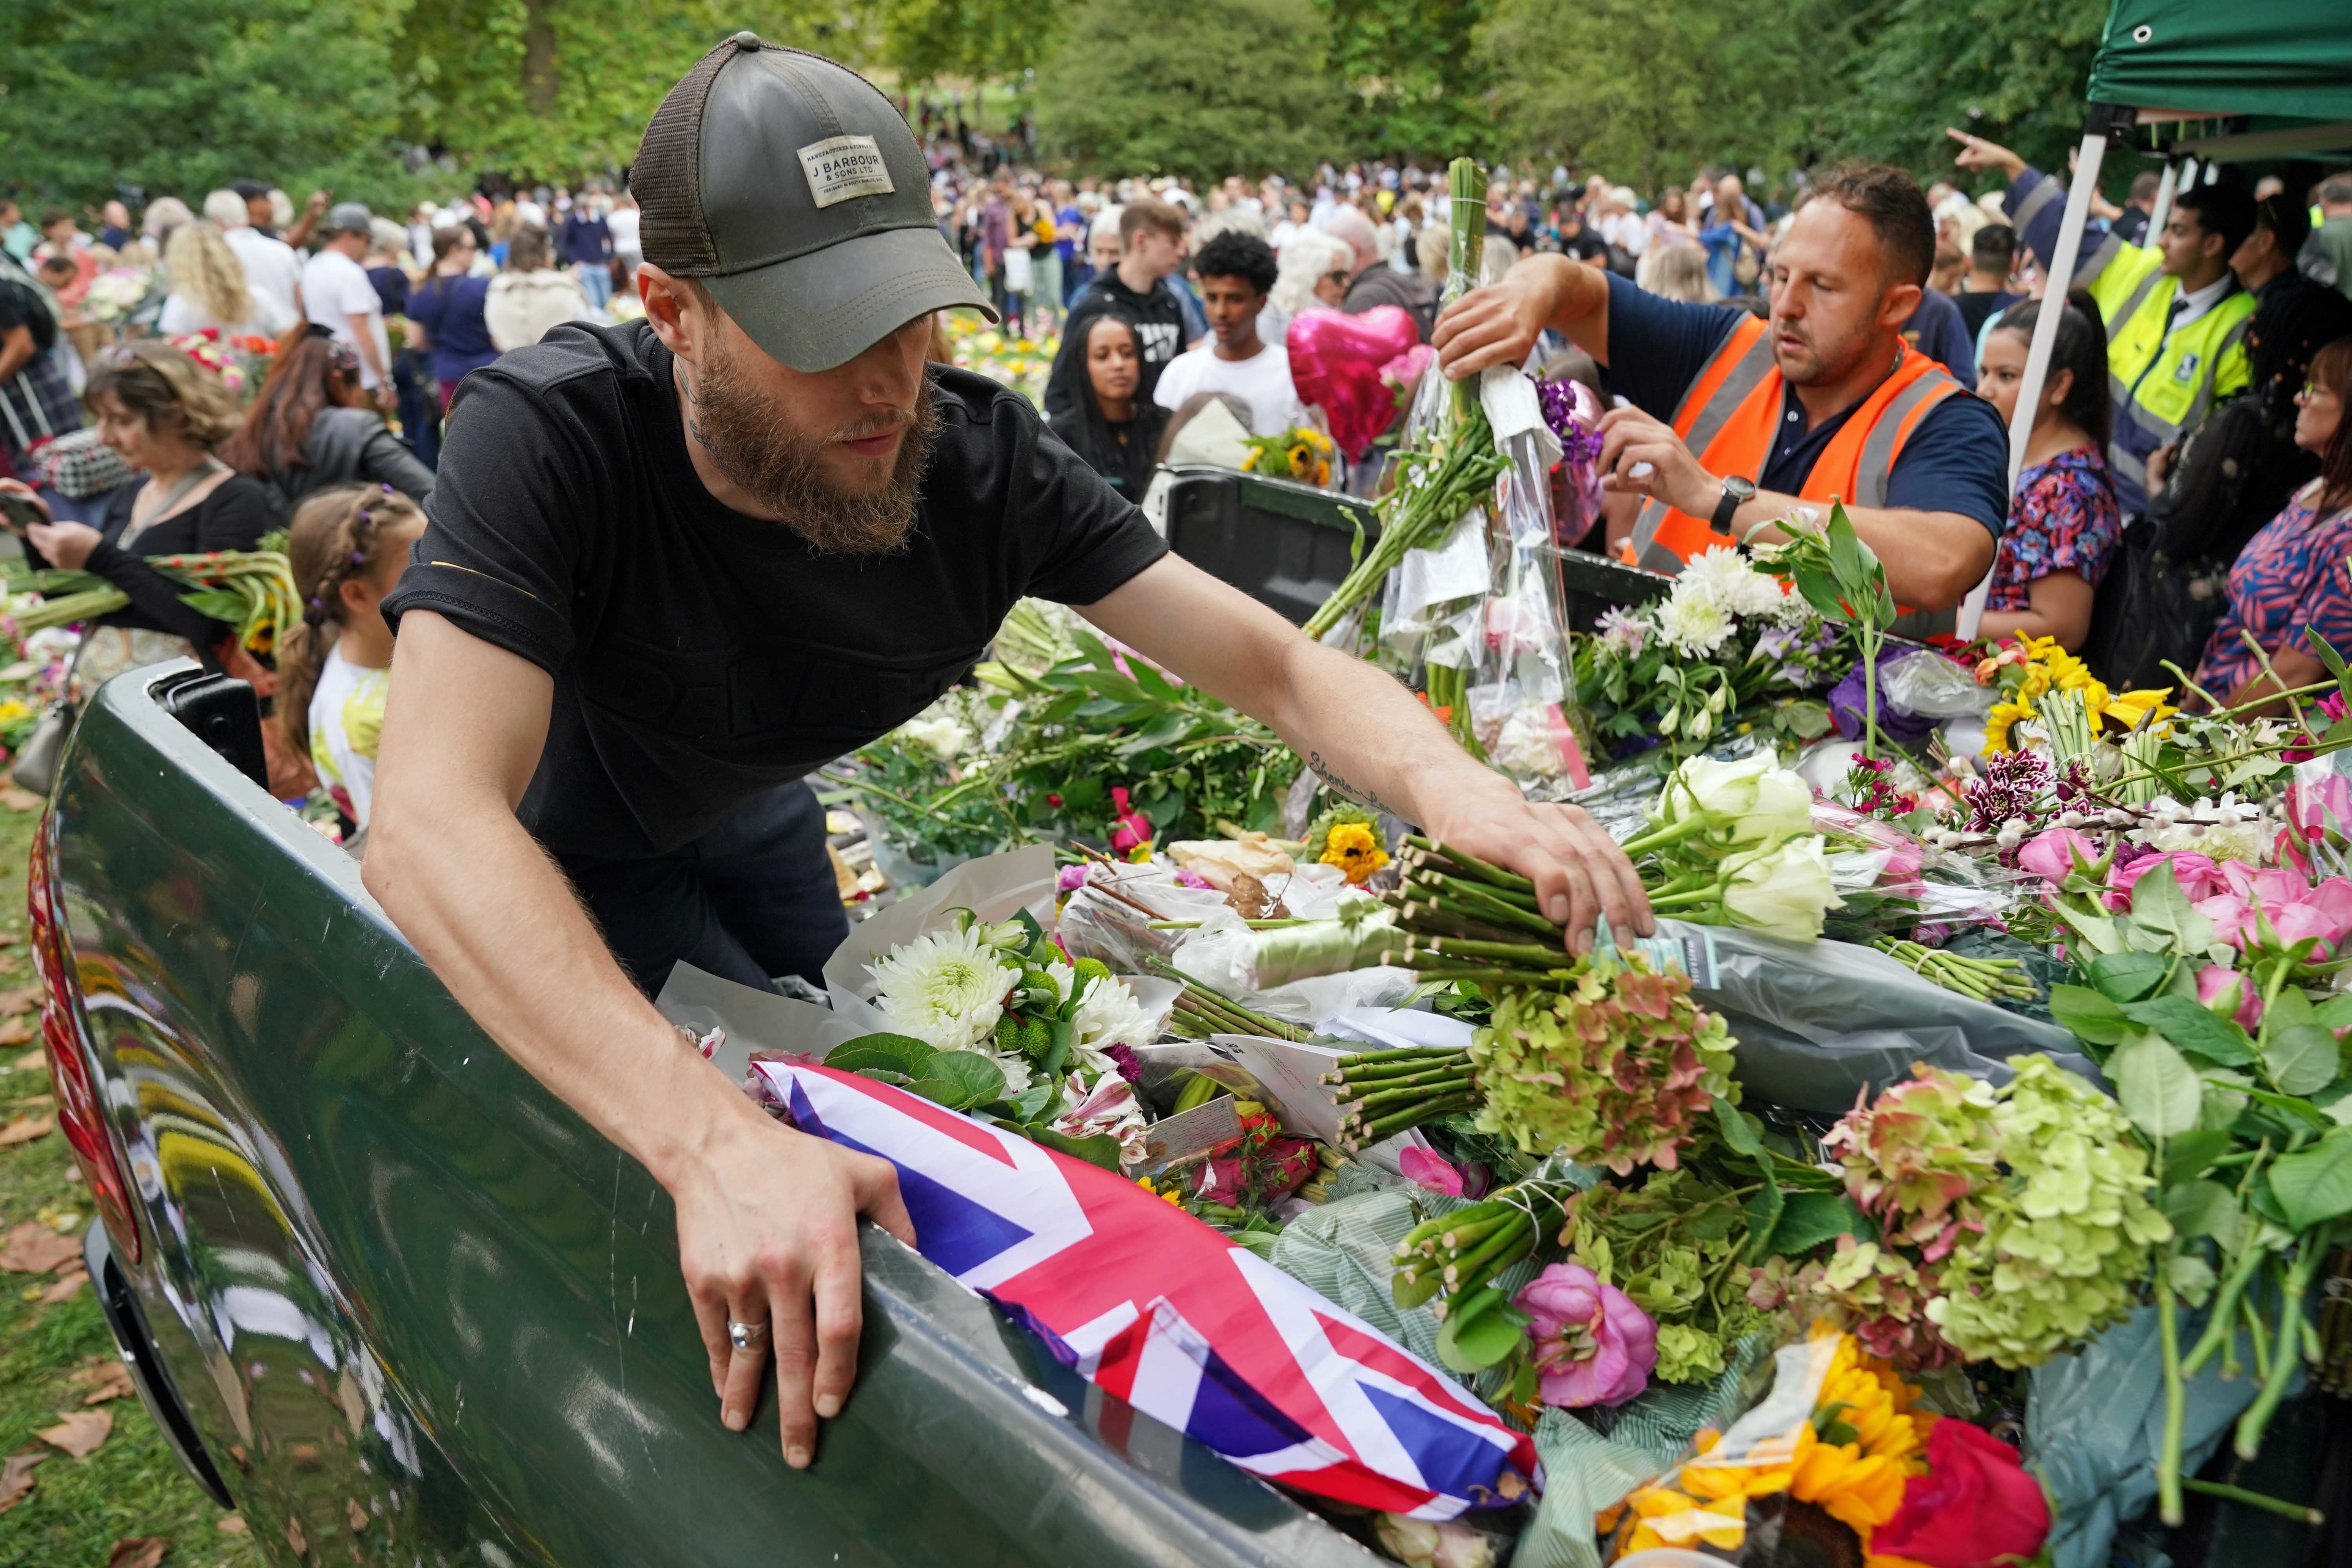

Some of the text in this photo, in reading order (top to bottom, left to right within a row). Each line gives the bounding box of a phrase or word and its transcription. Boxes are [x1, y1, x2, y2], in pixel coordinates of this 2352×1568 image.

[813, 155, 880, 177] J BARBOUR
[835, 168, 857, 179] SONS
